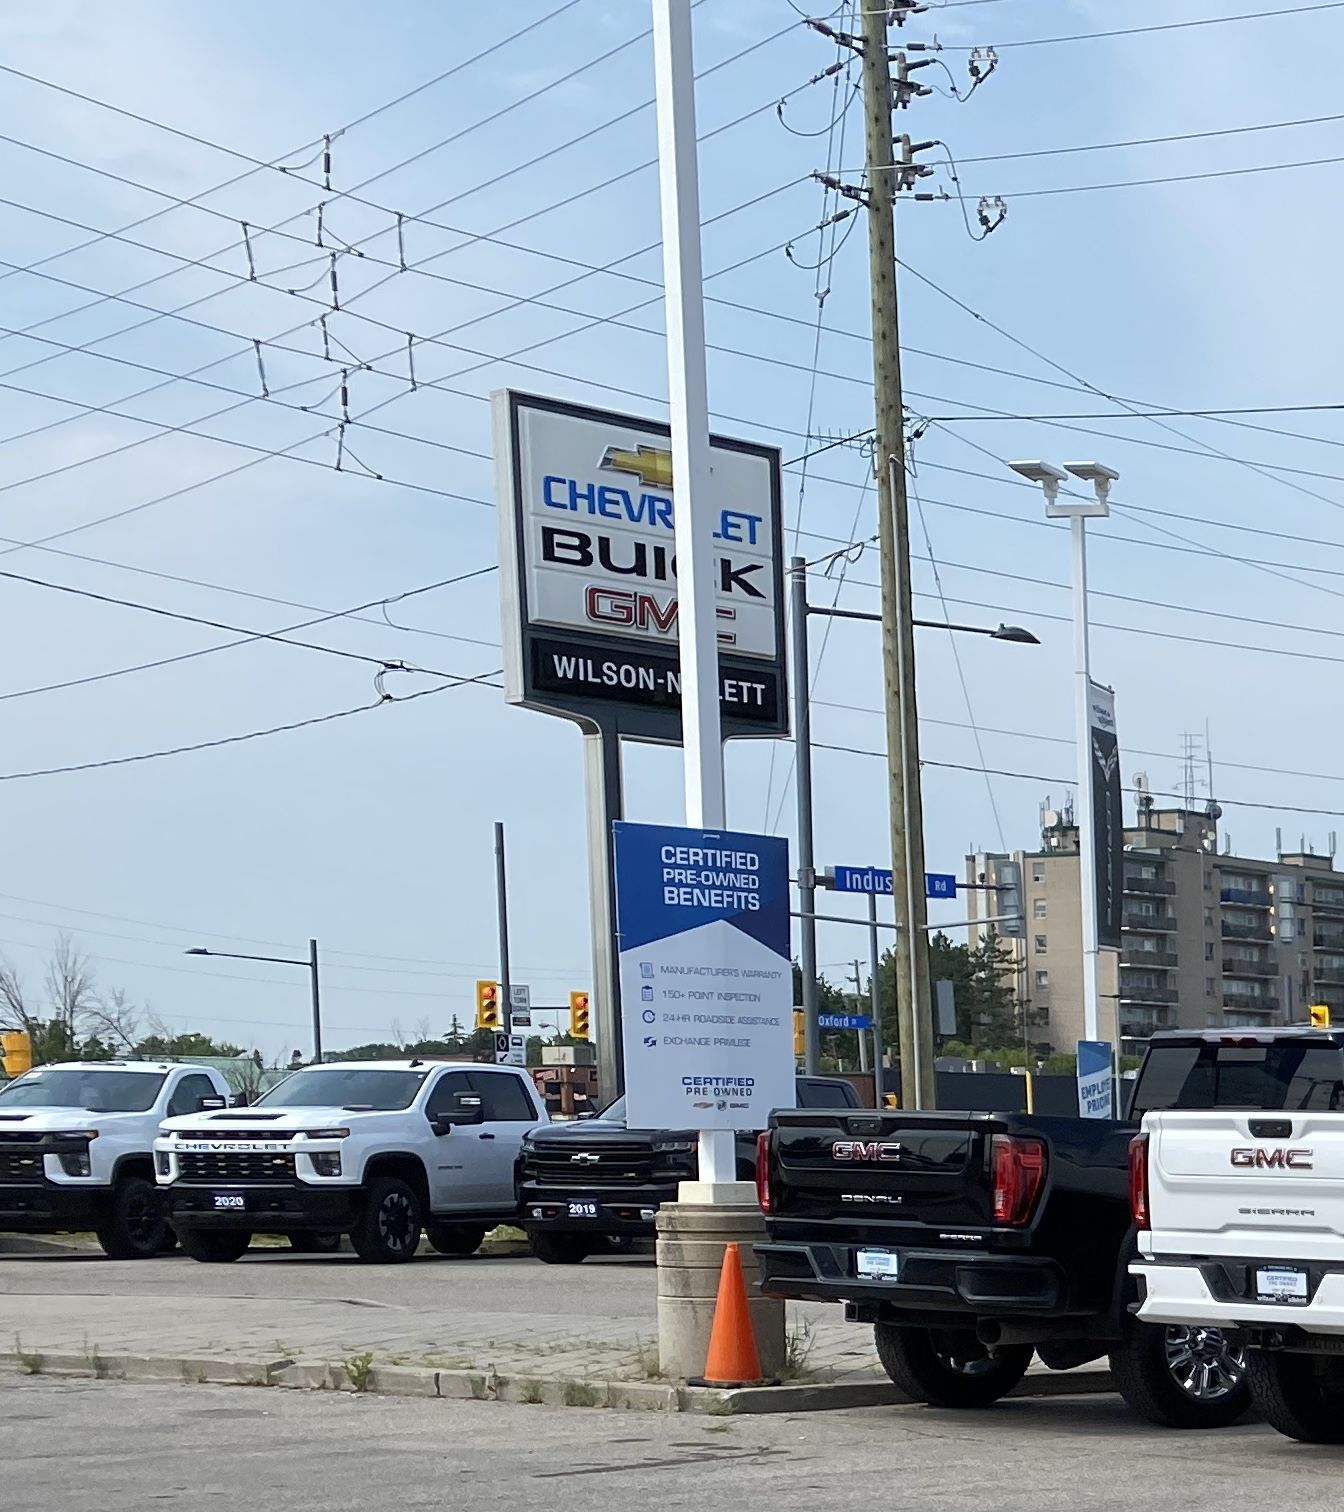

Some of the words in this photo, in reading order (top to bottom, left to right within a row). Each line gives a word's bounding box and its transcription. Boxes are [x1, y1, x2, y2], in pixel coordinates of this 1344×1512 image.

[543, 475, 763, 545] CHEVRET
[541, 525, 767, 600] BUIK
[661, 845, 760, 871] CERTIFIED
[663, 868, 760, 889] PRE-OWNED
[934, 880, 948, 893] Rd
[663, 886, 761, 911] BENEFITS
[662, 989, 685, 999] 150+
[687, 991, 714, 1001] POINT
[717, 992, 761, 1003] INSPECTION
[694, 1014, 736, 1025] ROADSIDE
[737, 1016, 780, 1027] ASSISTANCE
[818, 1014, 850, 1028] Oxford
[663, 1036, 711, 1047] EXCHANGE
[681, 1076, 755, 1087] CERTIFIED
[832, 1141, 901, 1162] GMC
[1230, 1147, 1313, 1170] GMC
[214, 1195, 244, 1206] 2020
[841, 1194, 902, 1203] DENALI
[568, 1203, 596, 1214] 2019
[1238, 1207, 1315, 1217] SIERRA
